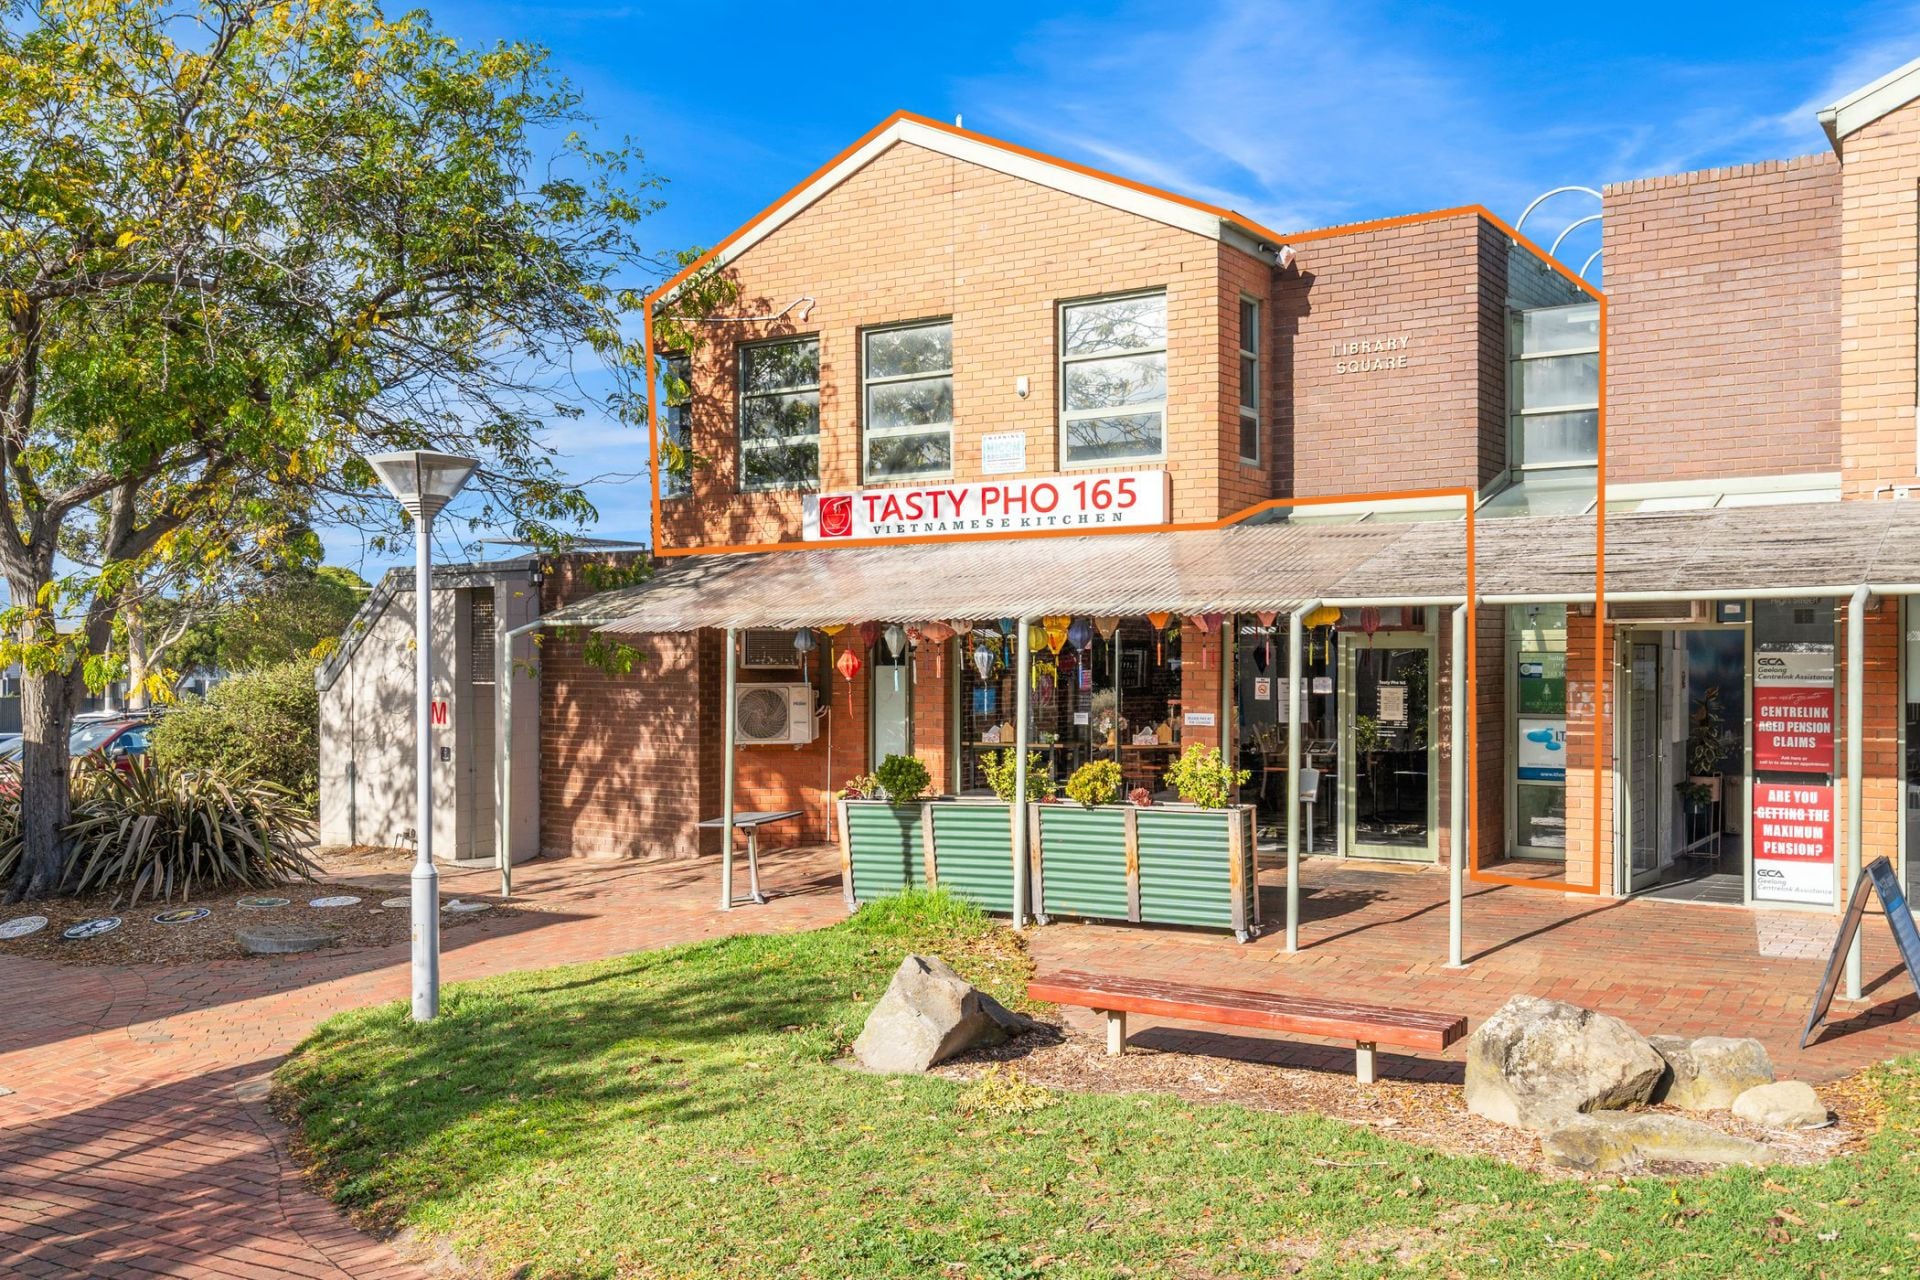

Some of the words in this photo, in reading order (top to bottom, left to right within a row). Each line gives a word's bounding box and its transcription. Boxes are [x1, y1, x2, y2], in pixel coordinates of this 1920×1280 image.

[1332, 336, 1409, 358] LIBRARY
[1336, 355, 1408, 375] SQUARE
[862, 489, 968, 522] TASTY
[981, 483, 1059, 516] PHO
[1073, 478, 1137, 510] 165
[873, 518, 1010, 534] VIETNAMESE
[1021, 512, 1123, 528] KITCHEN
[1757, 658, 1786, 666] GCA
[1757, 667, 1788, 675] Geelong
[1761, 706, 1829, 718] CENTRELINK
[1758, 721, 1785, 732] AGED
[1787, 721, 1831, 733] PENSION
[1773, 736, 1816, 748] CLAIMS
[1768, 790, 1791, 802] ARE
[1793, 791, 1818, 804] YOU
[1757, 806, 1805, 820] GETTING
[1807, 808, 1830, 822] THE
[1763, 824, 1823, 839] MAXIMUM
[1763, 841, 1823, 856] PENSION?
[1757, 869, 1784, 878] GCA
[1757, 878, 1787, 886] Geelong
[1757, 884, 1793, 893] Centrelink
